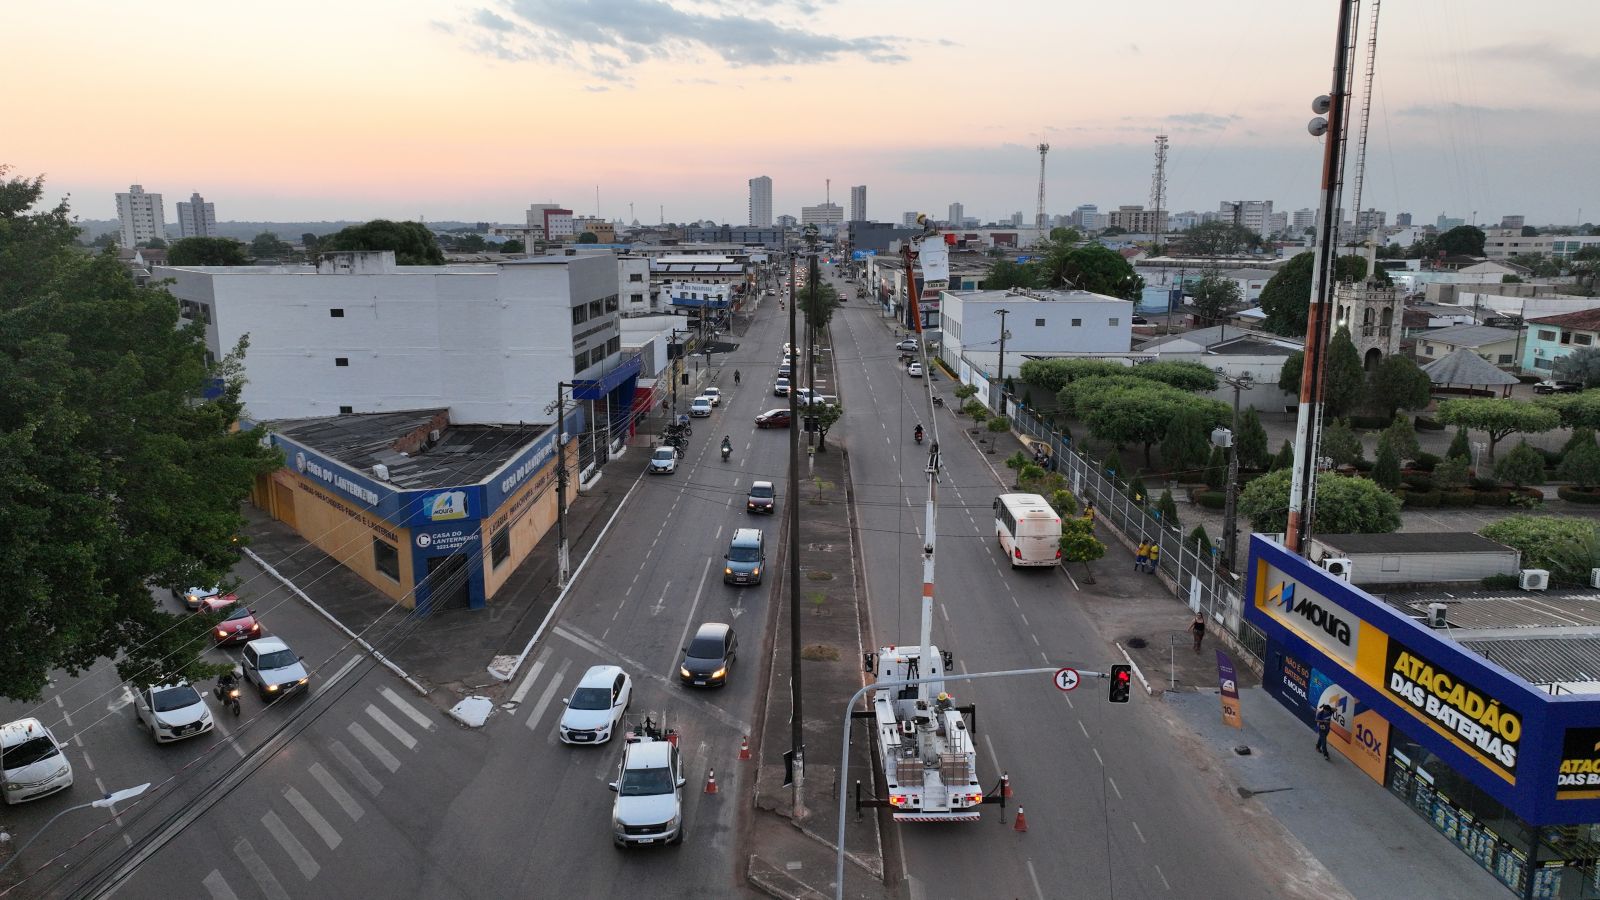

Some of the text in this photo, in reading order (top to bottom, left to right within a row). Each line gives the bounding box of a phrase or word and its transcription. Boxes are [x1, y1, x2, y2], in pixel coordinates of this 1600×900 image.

[323, 468, 333, 483] DO
[1394, 651, 1521, 743] ATACADÃO
[1391, 672, 1425, 707] DAS
[1425, 695, 1517, 768] BATERIAS
[1356, 723, 1382, 756] 10x
[1557, 774, 1587, 786] DAS
